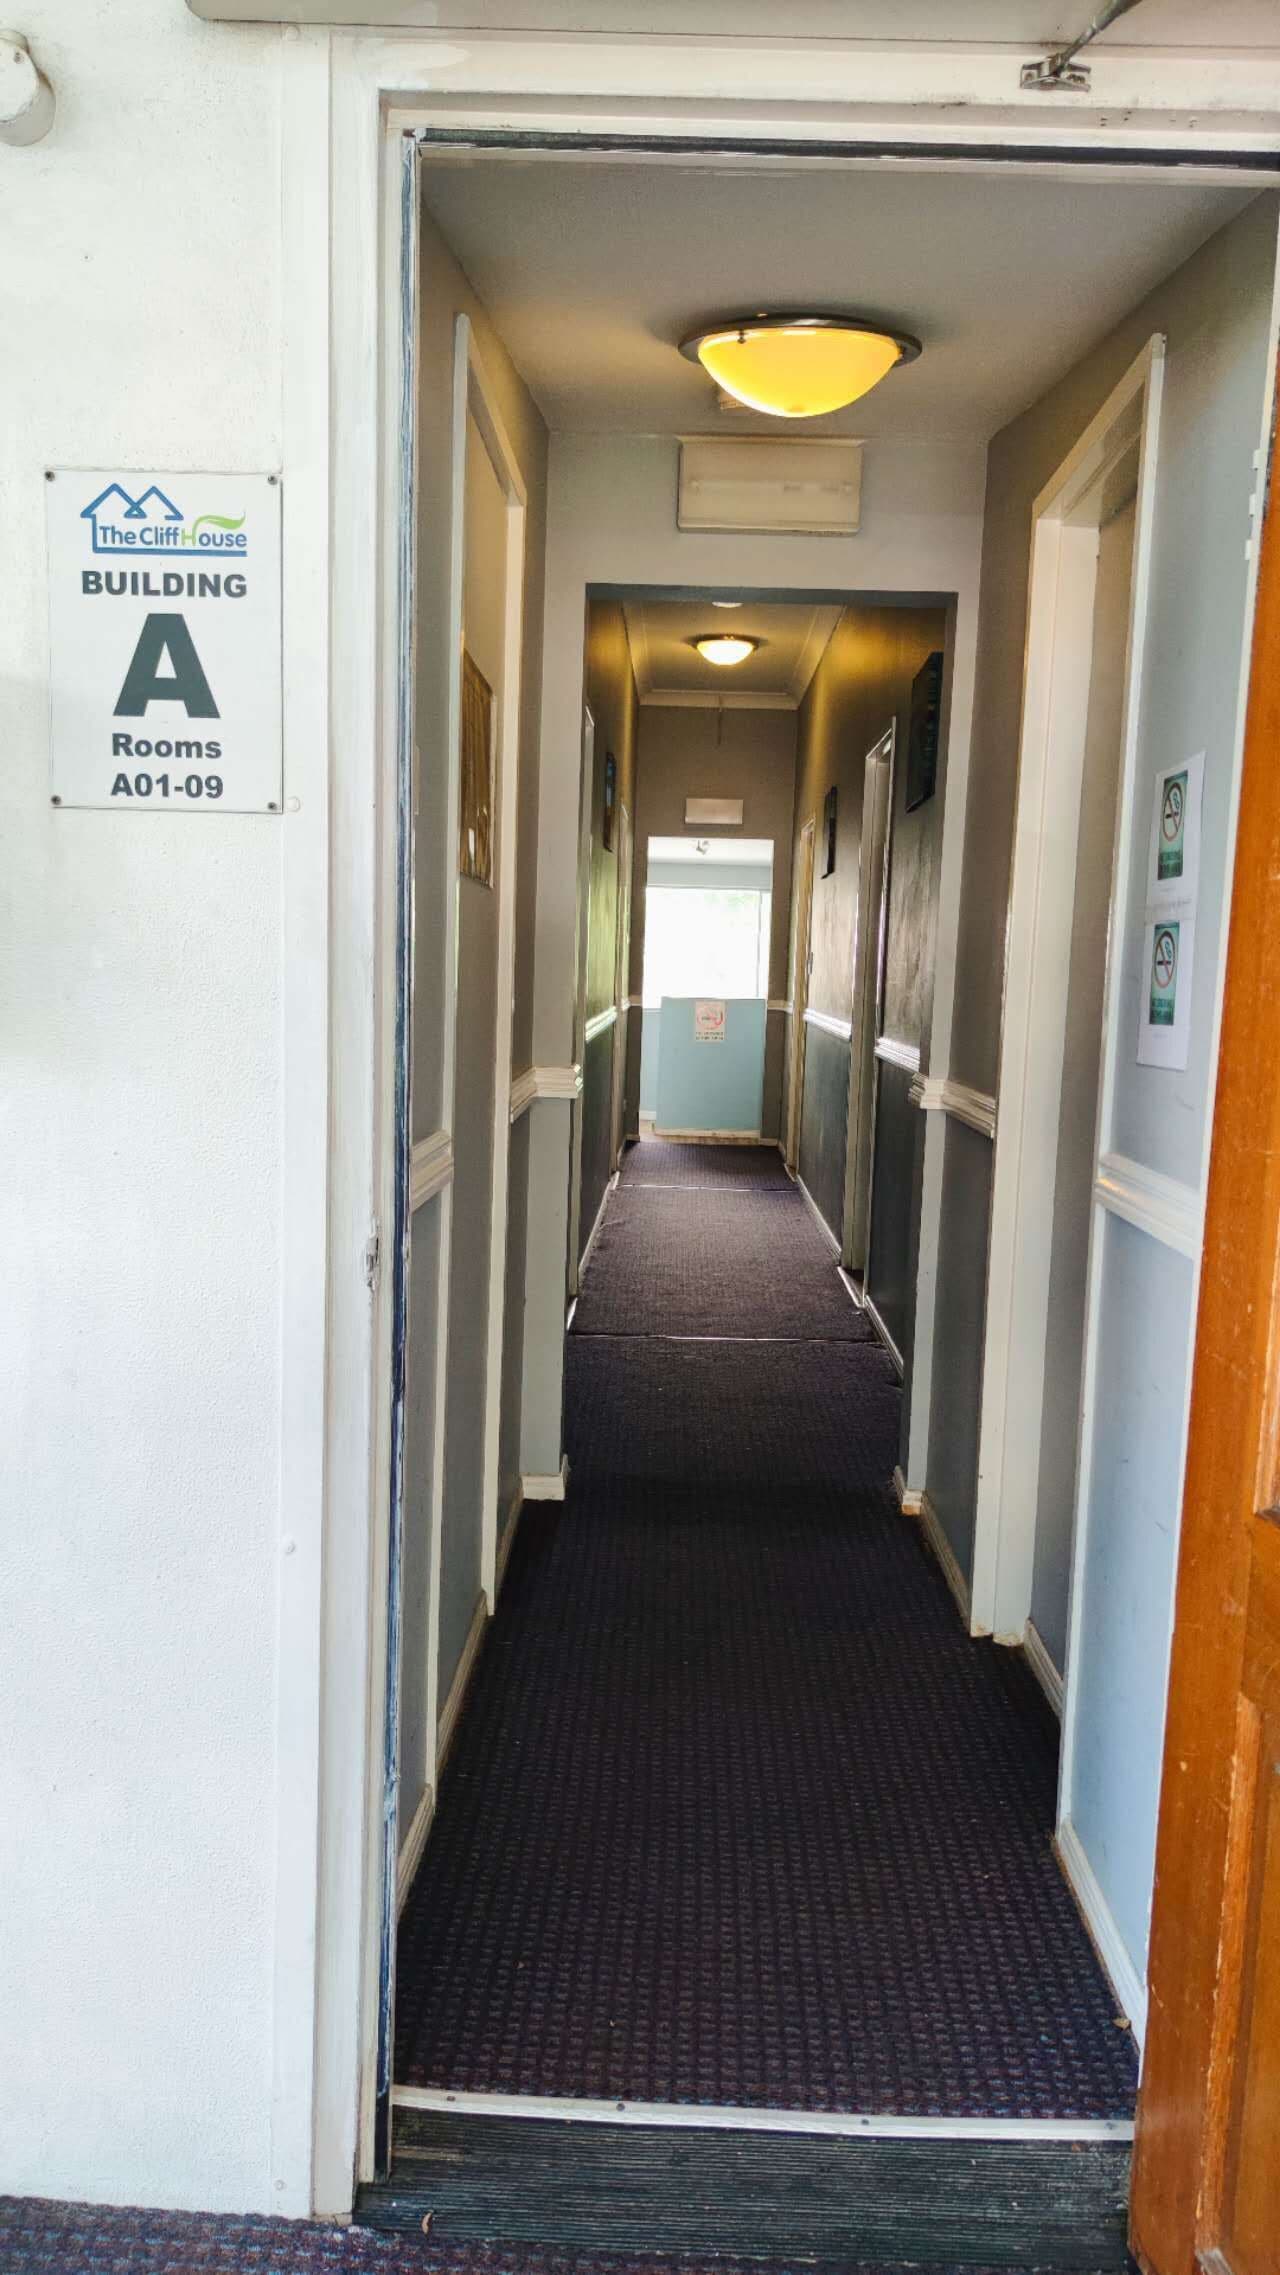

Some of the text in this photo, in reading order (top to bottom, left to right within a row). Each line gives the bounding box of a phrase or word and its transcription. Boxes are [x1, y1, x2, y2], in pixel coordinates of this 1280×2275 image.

[82, 570, 248, 598] BUILDING
[112, 612, 222, 719] A
[111, 732, 223, 760] Rooms
[110, 772, 224, 799] A01-09
